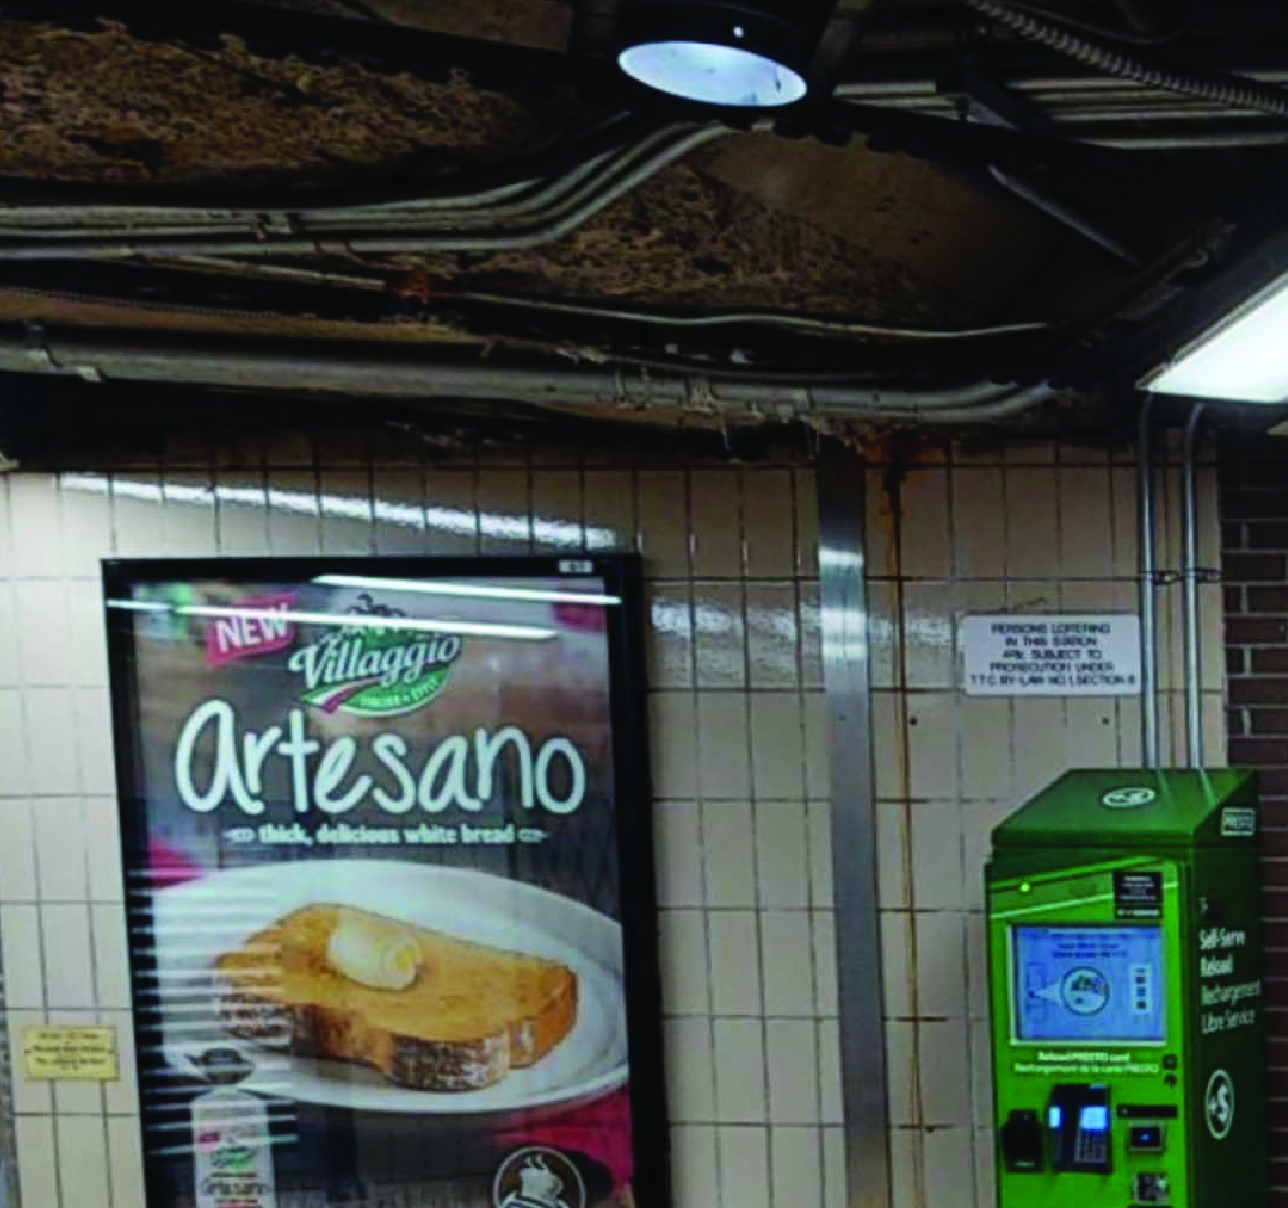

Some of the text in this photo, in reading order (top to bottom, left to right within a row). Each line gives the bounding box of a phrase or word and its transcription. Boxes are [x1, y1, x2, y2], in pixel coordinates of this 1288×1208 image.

[215, 602, 289, 653] NEW
[288, 632, 463, 690] Villaggio
[315, 823, 400, 844] delicious
[403, 823, 457, 844] white
[459, 823, 515, 844] bread
